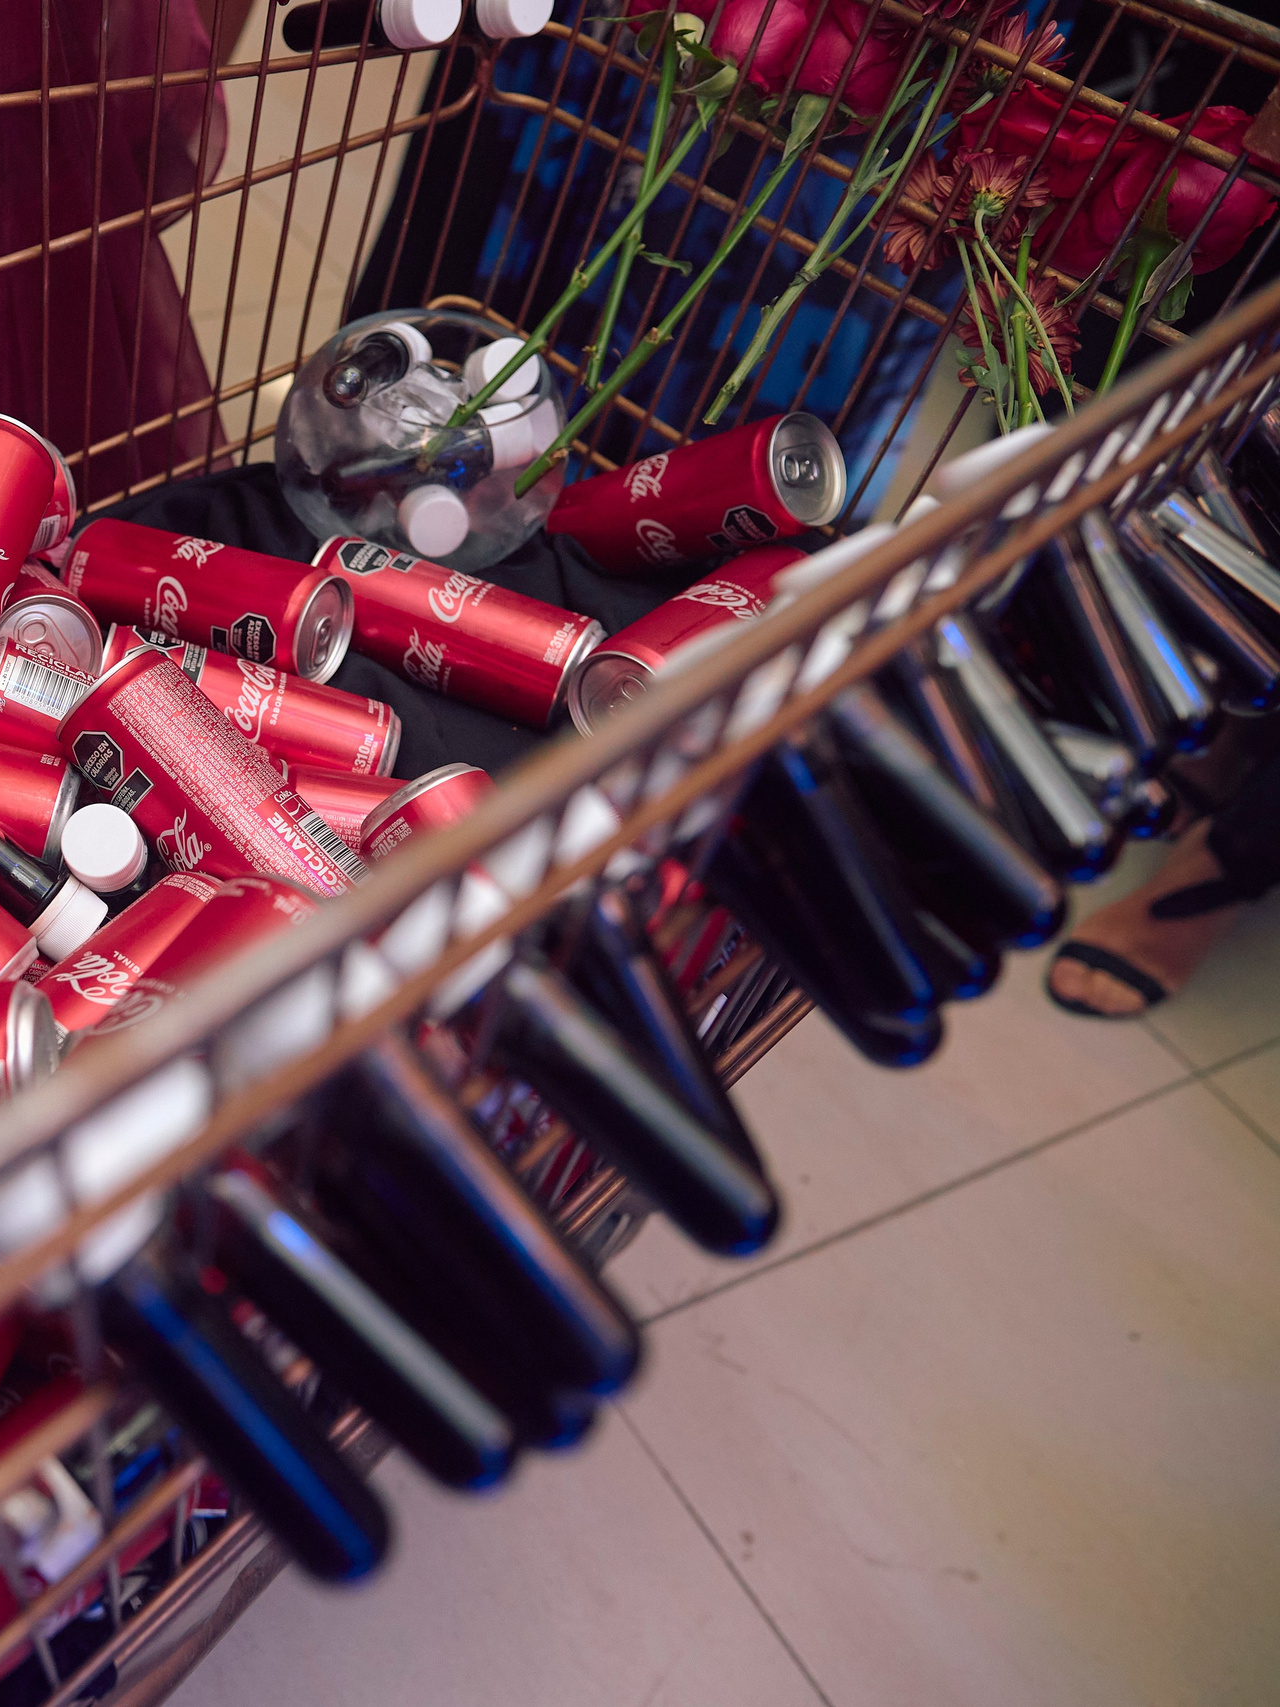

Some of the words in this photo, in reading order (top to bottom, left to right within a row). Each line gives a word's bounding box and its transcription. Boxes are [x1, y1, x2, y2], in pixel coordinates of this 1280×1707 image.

[550, 629, 567, 649] 310
[15, 642, 99, 684] RECICLAM
[270, 699, 281, 726] SABOR
[80, 749, 103, 772] EXCESO
[95, 739, 110, 754] EN
[85, 746, 116, 778] CALORÍAS
[355, 745, 371, 767] 310
[291, 822, 316, 849] PRONTO
[313, 846, 336, 869] VEMOS
[109, 948, 145, 978] IGINAL
